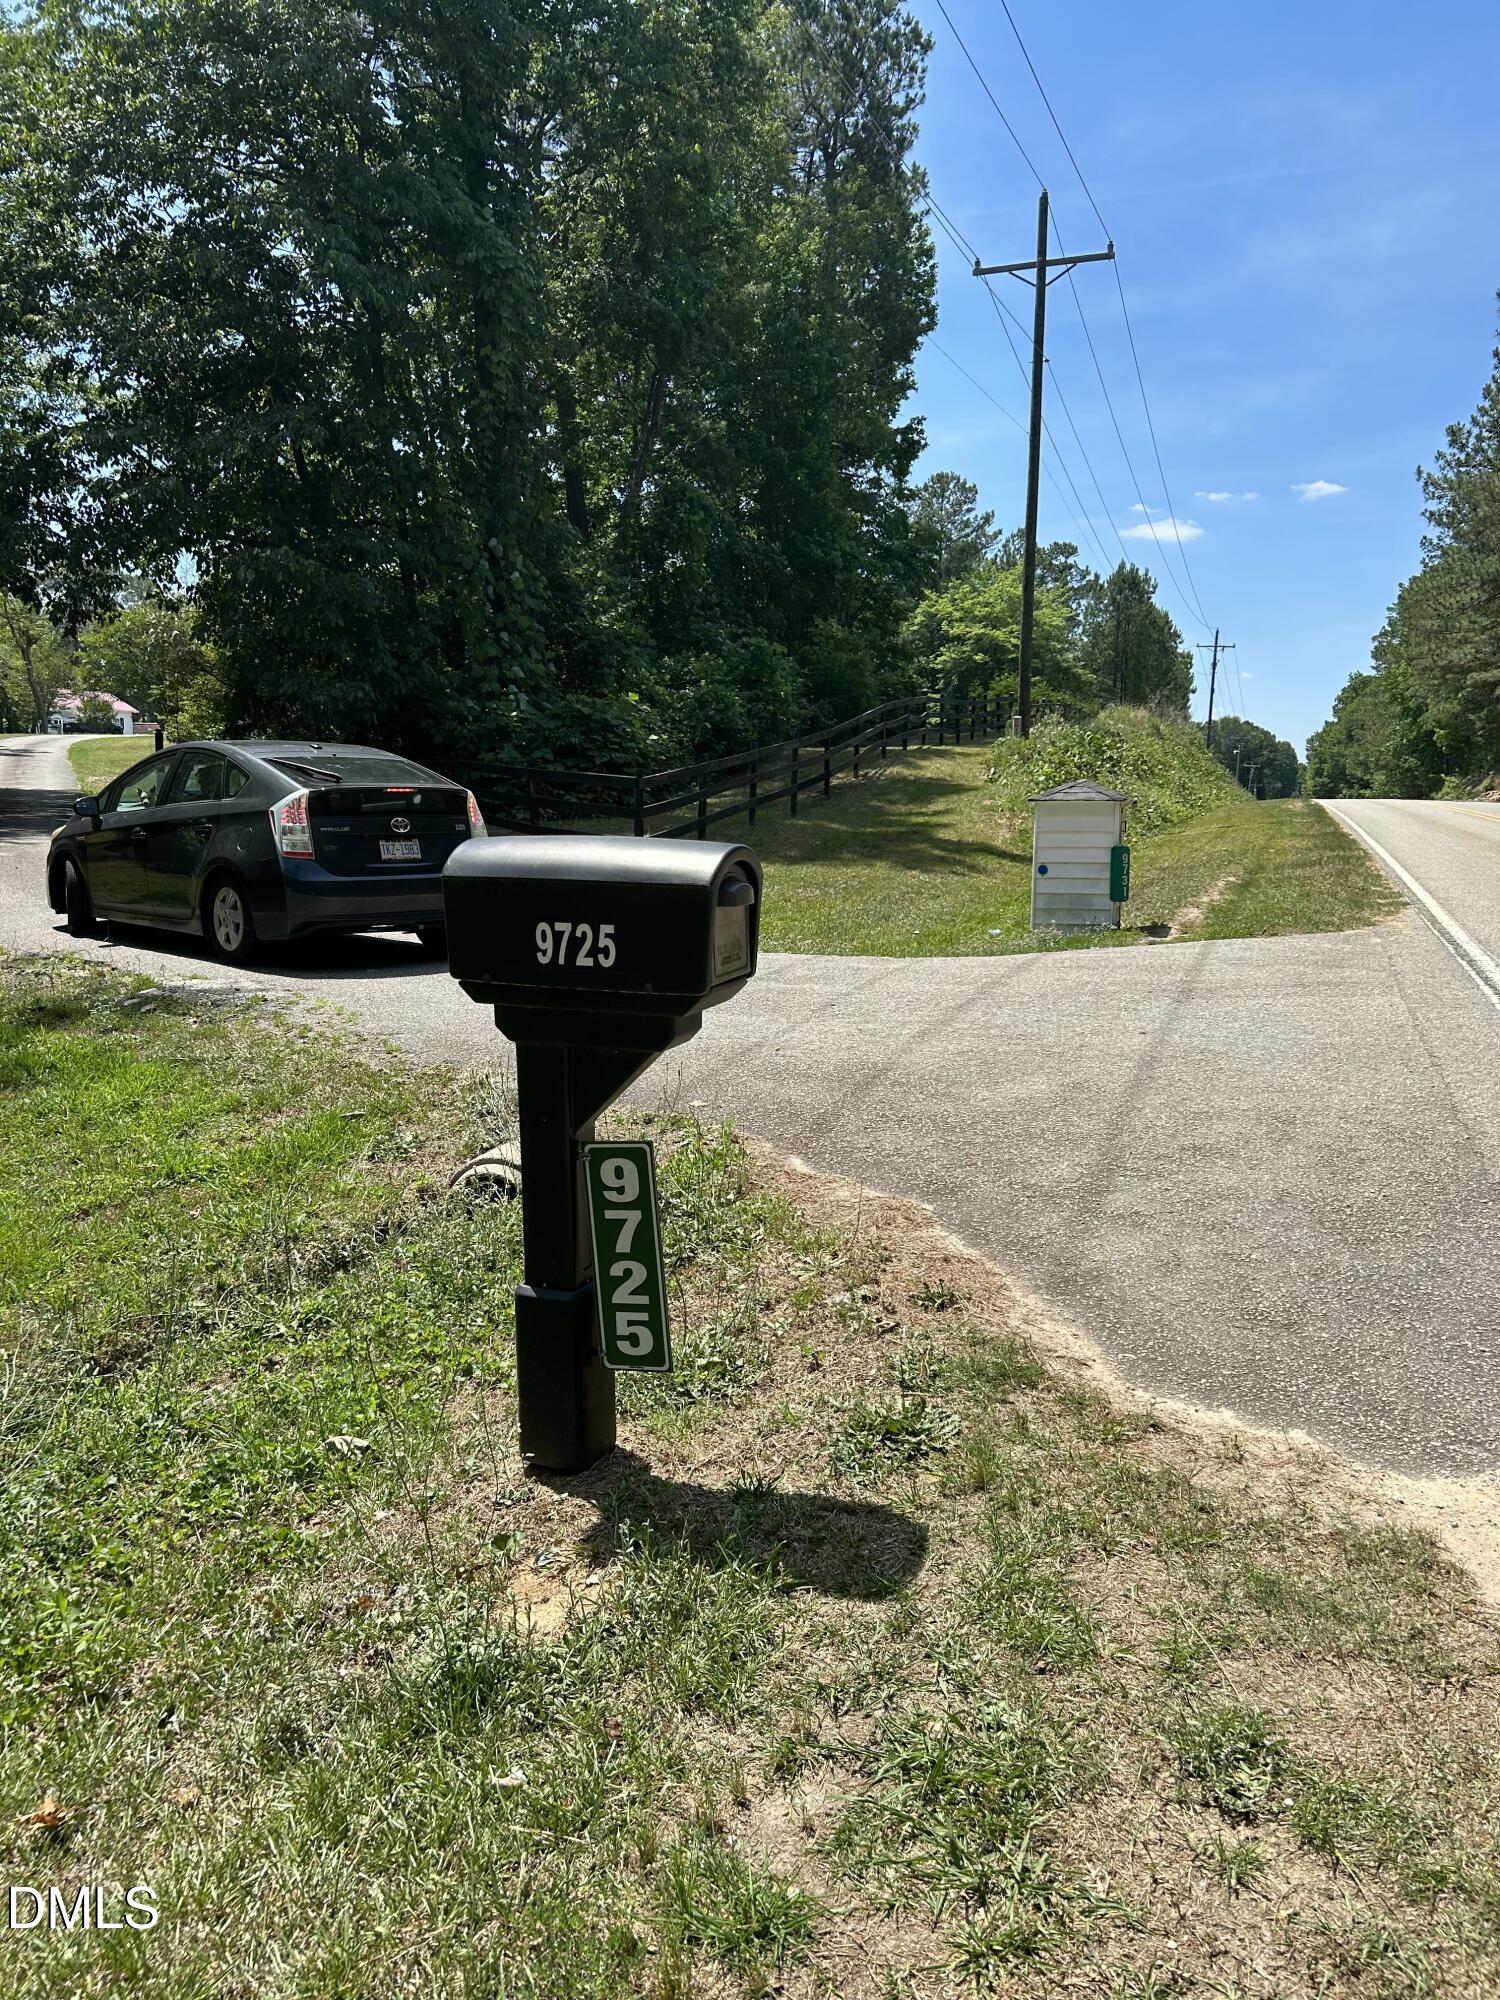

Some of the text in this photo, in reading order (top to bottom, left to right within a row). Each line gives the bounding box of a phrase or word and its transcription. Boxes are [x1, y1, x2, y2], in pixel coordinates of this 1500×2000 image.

[1121, 853, 1129, 897] 9731
[535, 921, 616, 968] 9725
[600, 1157, 654, 1356] 9725
